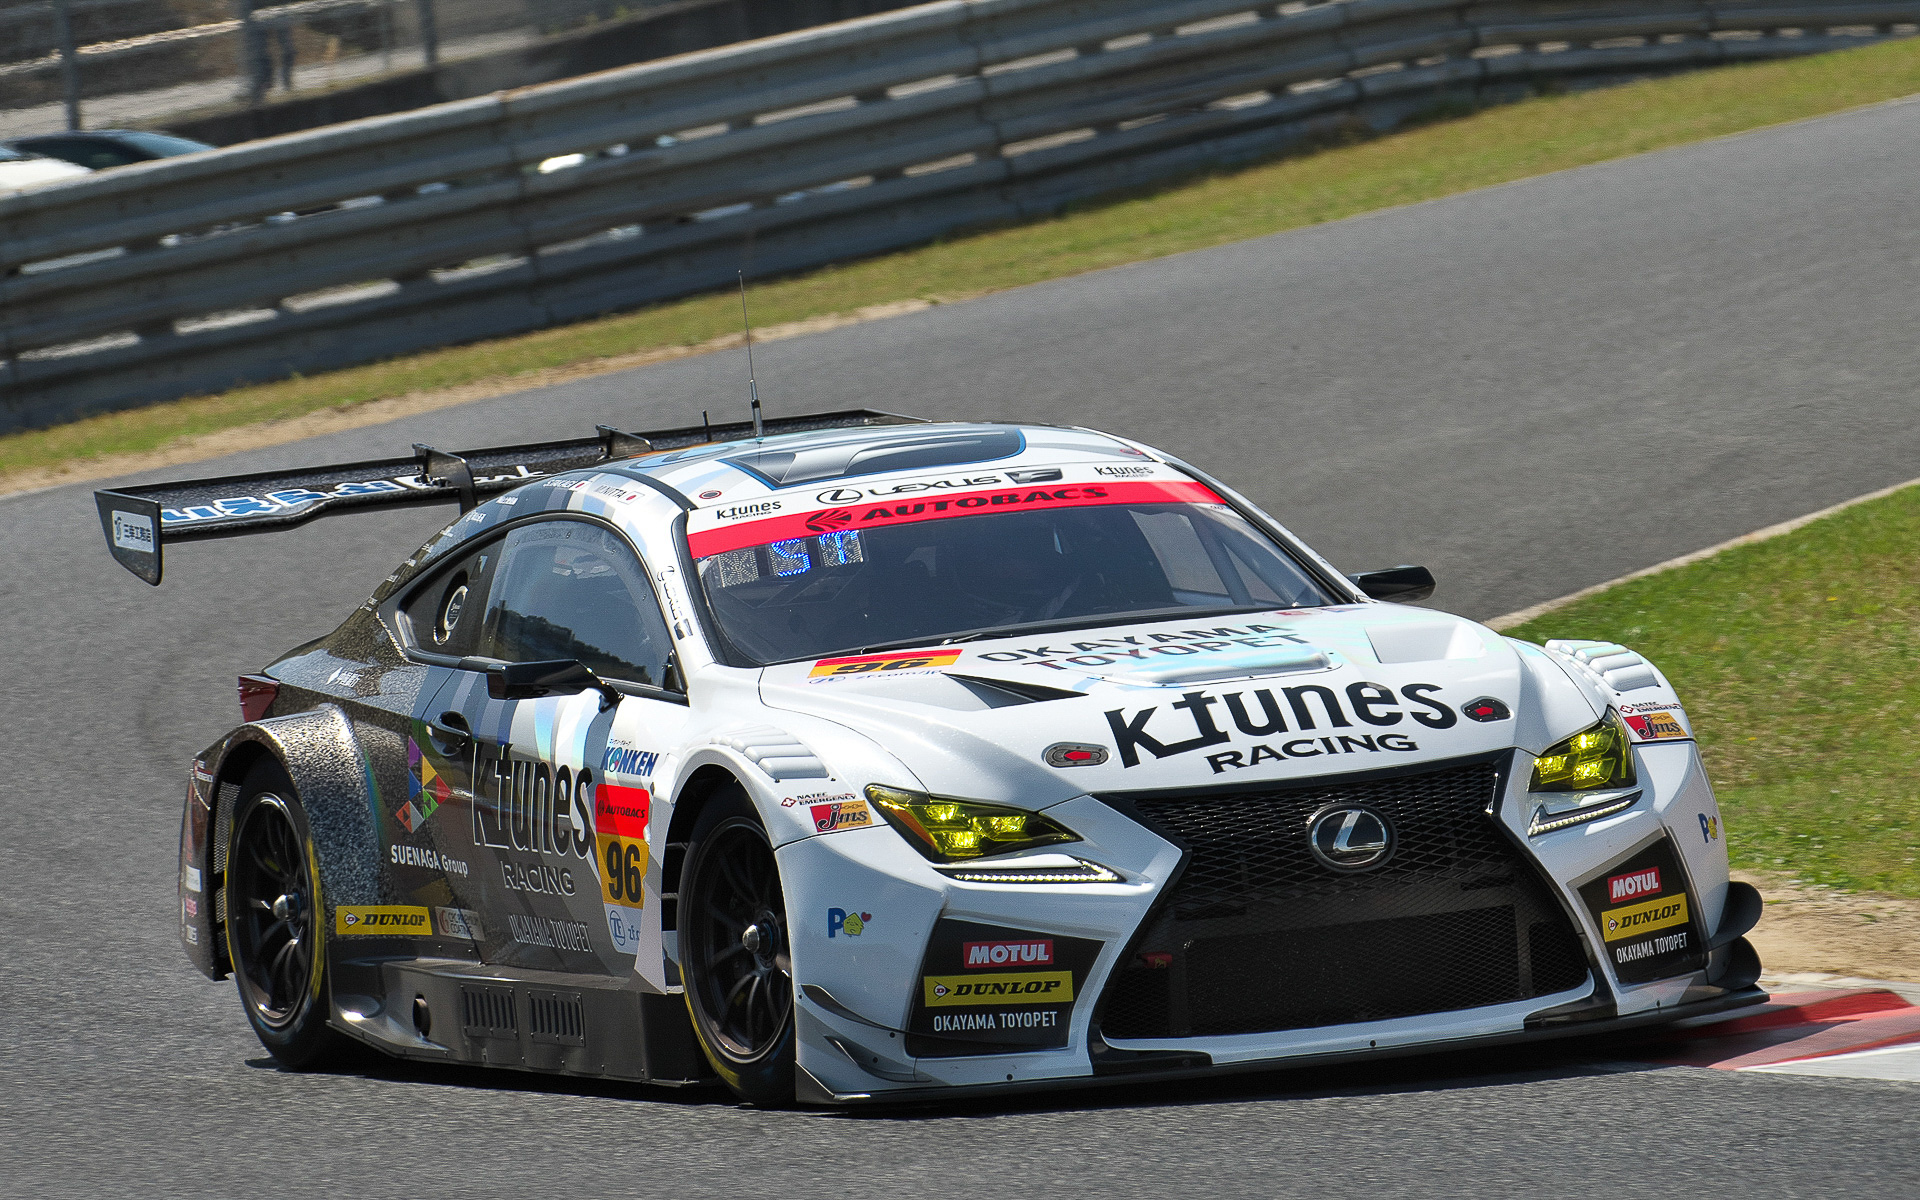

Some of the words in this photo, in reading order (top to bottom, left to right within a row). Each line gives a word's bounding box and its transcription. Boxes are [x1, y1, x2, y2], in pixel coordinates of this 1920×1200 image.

[869, 475, 1002, 496] LEXUS
[860, 486, 1109, 521] AUTOBACS
[977, 624, 1294, 662] OKAYAMA
[1021, 633, 1311, 671] TOYOPET
[831, 657, 934, 676] 96
[1203, 733, 1420, 775] RACING
[797, 791, 828, 800] NATEC
[799, 794, 857, 806] EMERGENCY
[605, 804, 646, 819] AUTOBACS
[391, 844, 442, 871] SUENAGA
[441, 854, 469, 878] Group
[606, 840, 642, 904] 96
[500, 860, 576, 897] RACING
[1612, 871, 1659, 899] MOTUL
[361, 913, 426, 926] DUNLOP
[1620, 903, 1681, 929] DUNLOP
[549, 919, 593, 953] TOYOPET
[1616, 940, 1655, 964] OKAYAMA
[1654, 932, 1688, 955] TOYOPET
[968, 943, 1050, 965] MOTUL
[953, 980, 1062, 997] DUNLOP
[933, 1013, 996, 1032] OKAYAMA
[999, 1011, 1058, 1029] TOYOPET
